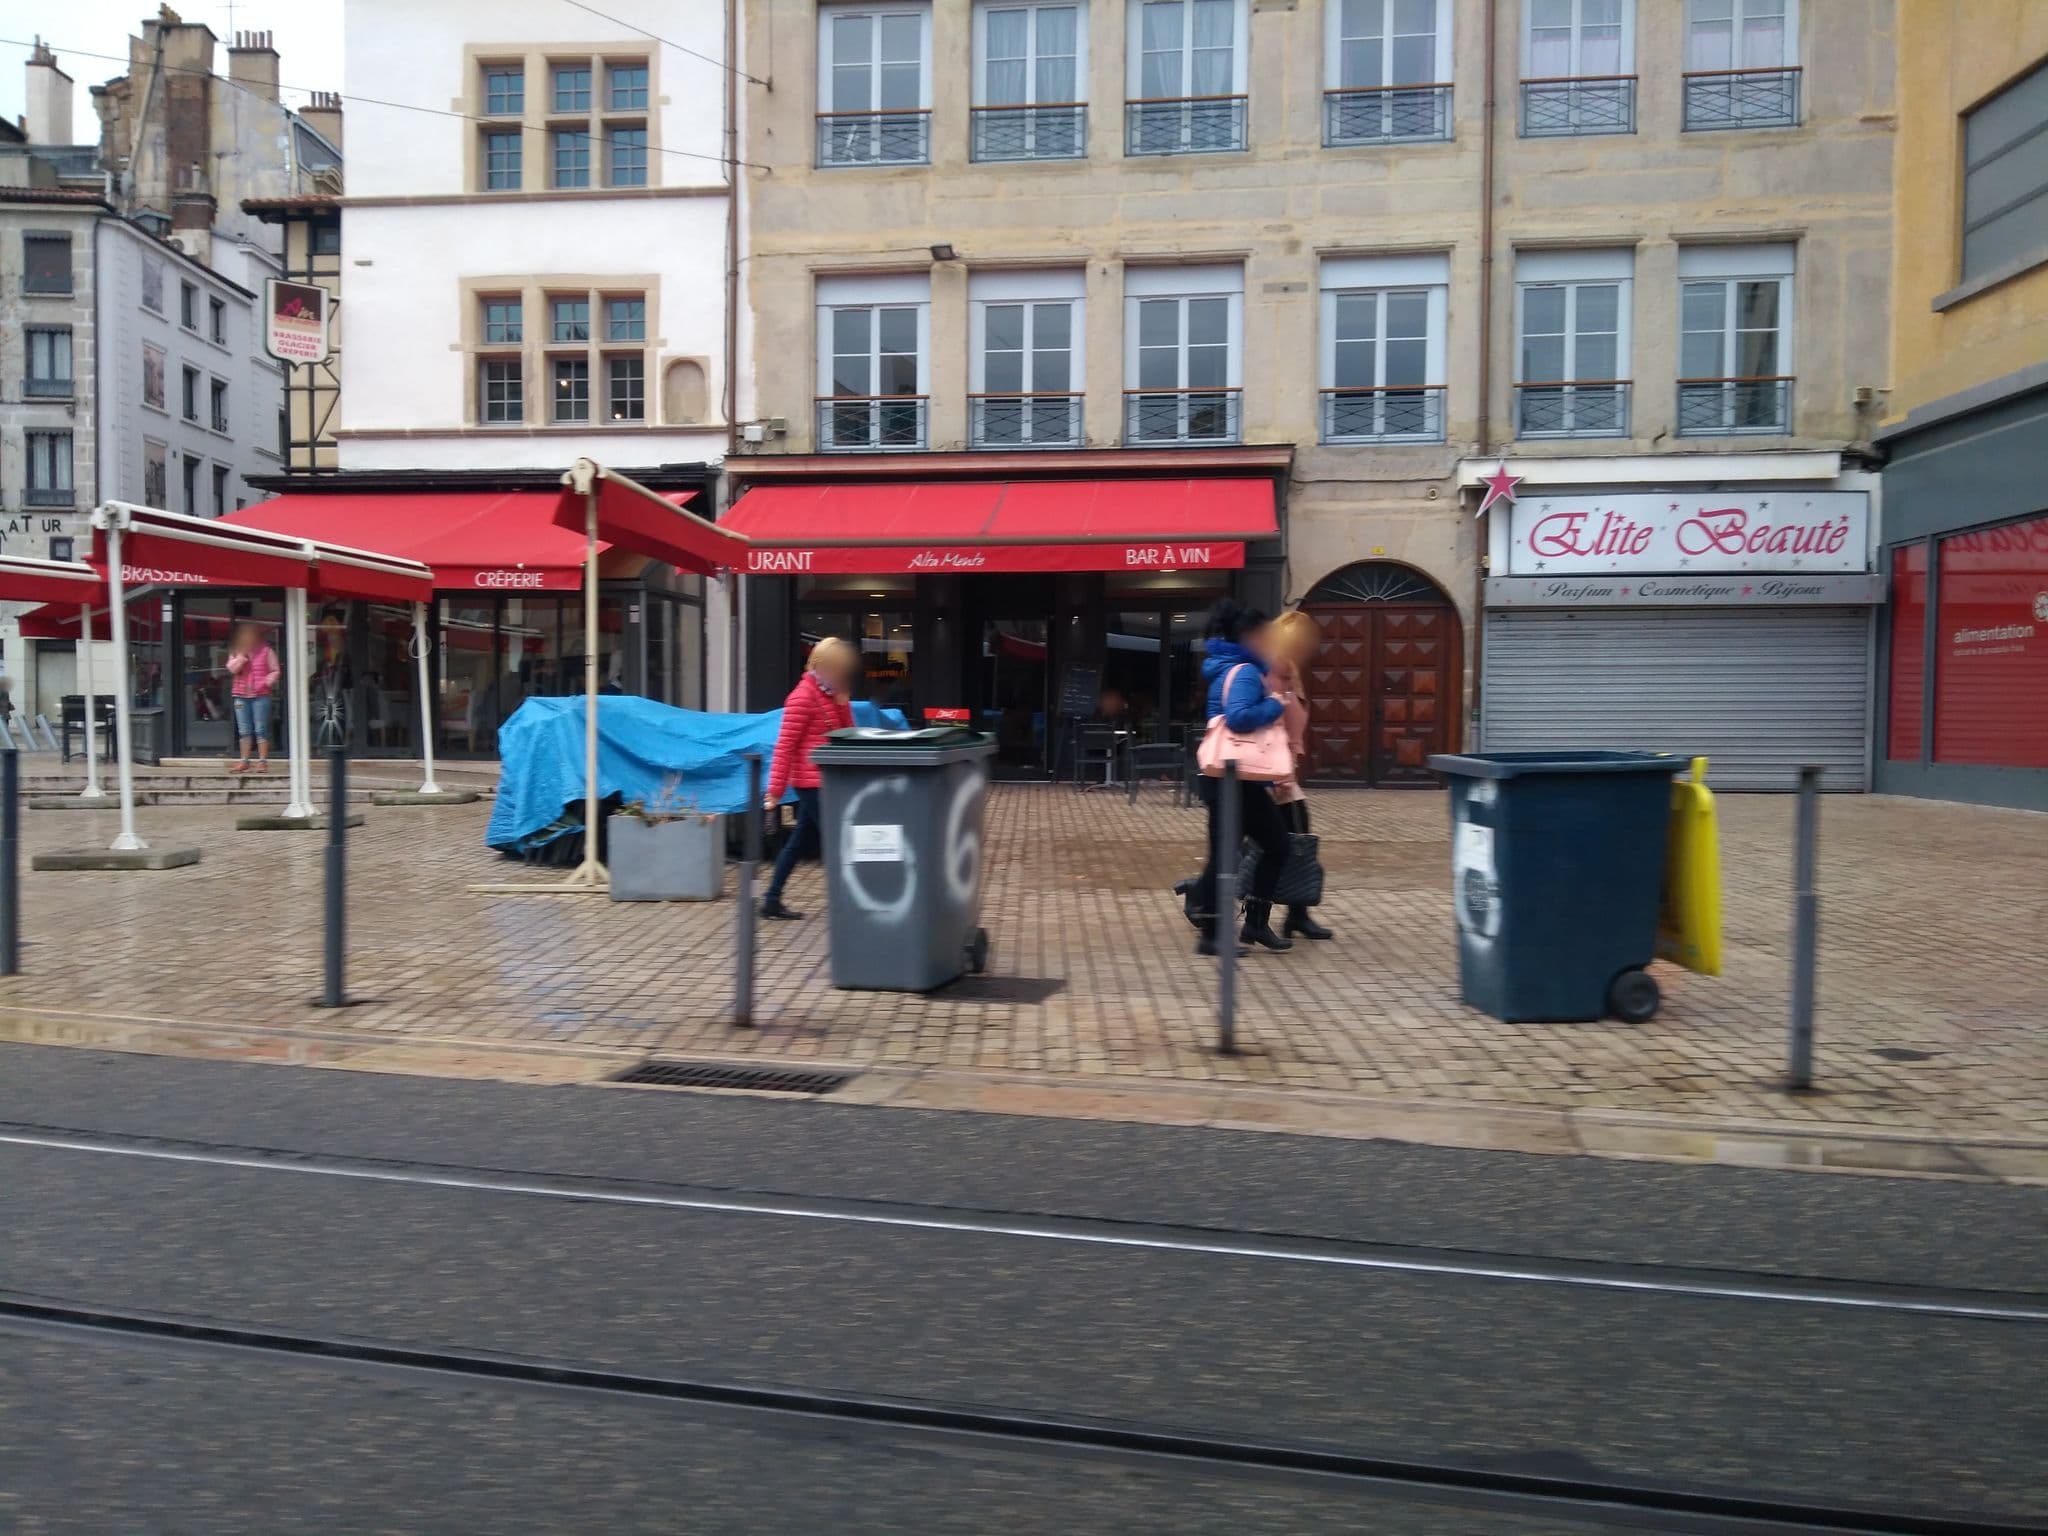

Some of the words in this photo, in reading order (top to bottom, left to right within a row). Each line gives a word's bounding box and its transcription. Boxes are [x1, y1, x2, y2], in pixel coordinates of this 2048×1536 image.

[273, 330, 321, 344] BRASSERIE
[278, 339, 317, 351] GLACIER
[1529, 510, 1653, 557] Elite
[1676, 507, 1850, 556] Beauté
[732, 552, 813, 570] URANT
[1126, 548, 1159, 565] BAR
[1162, 545, 1176, 564] À
[1179, 548, 1210, 563] VIN
[474, 569, 544, 588] CRÊPERIE
[1542, 582, 1614, 600] Parfum
[1758, 581, 1825, 599] Bijoux
[1953, 624, 2034, 643] alimentation
